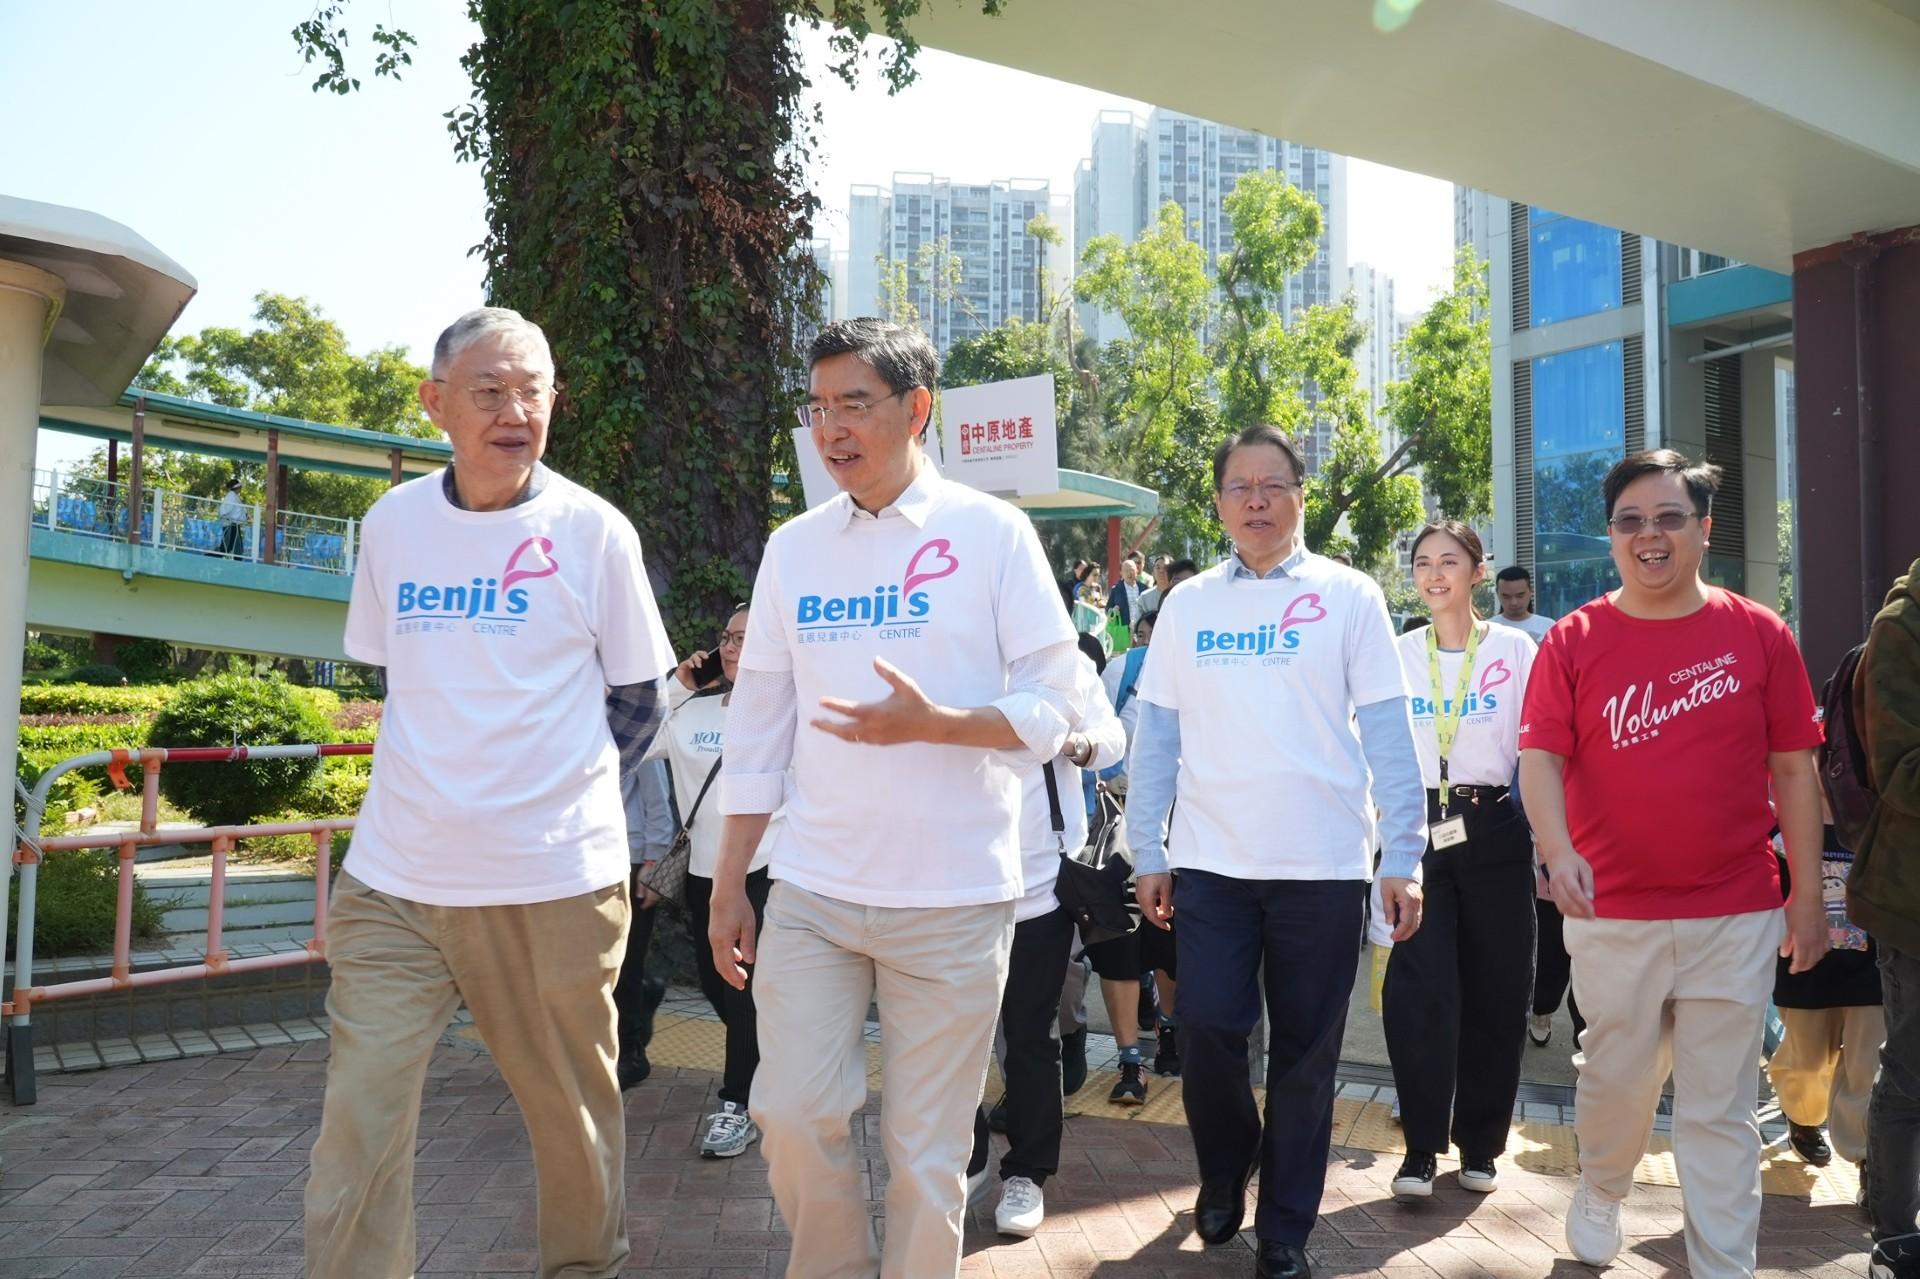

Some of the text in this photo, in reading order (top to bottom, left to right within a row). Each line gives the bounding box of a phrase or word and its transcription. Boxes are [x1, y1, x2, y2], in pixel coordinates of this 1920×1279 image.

[971, 416, 1033, 444] 中原地產
[472, 622, 518, 637] CENTRE
[879, 627, 921, 640] CENTRE
[1668, 652, 1738, 685] CENTALINE
[1602, 669, 1740, 743] Volunteer
